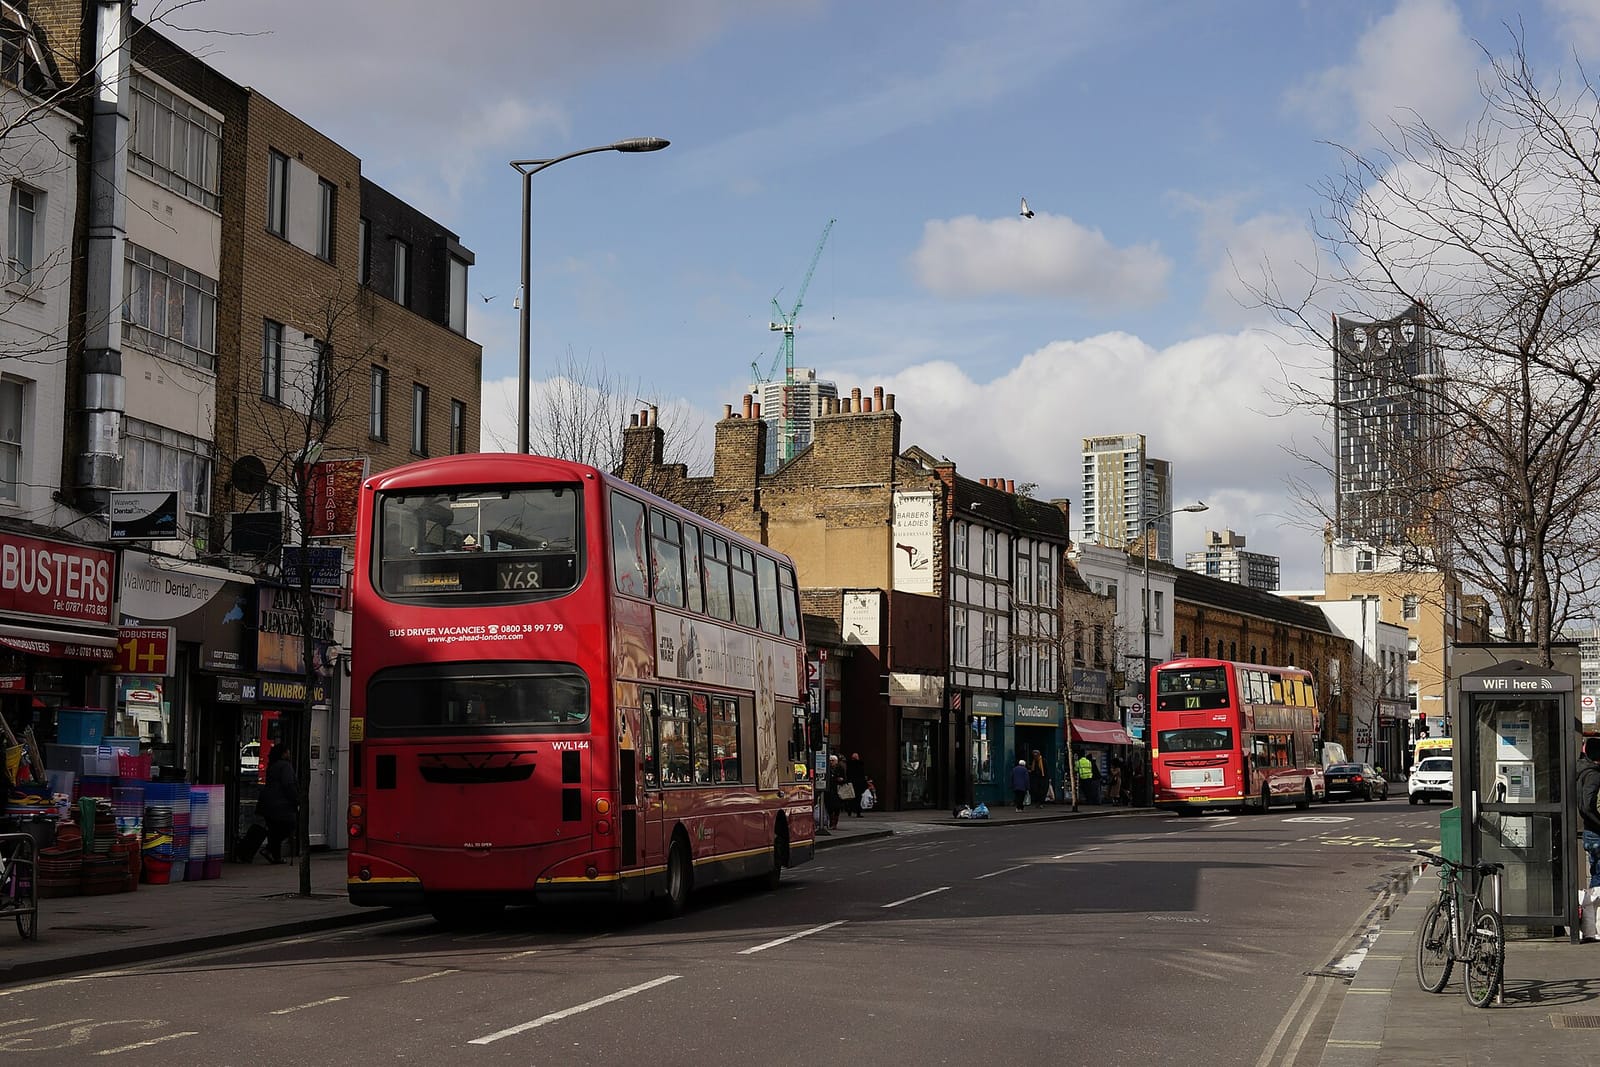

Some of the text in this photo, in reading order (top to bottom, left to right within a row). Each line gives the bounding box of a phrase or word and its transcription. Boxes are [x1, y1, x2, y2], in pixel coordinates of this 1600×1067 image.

[325, 463, 336, 531] KEBABS
[896, 511, 930, 520] BARBERS
[903, 519, 930, 527] LADIES
[0, 544, 109, 602] BUSTERS
[124, 571, 209, 601] Walworth DentalCare
[65, 602, 83, 612] 07871
[389, 623, 564, 637] BUS DRIVER VACANCIES 0800 38 99 7 99
[427, 632, 523, 644] www.go-ahead-london.com
[820, 650, 828, 660] H
[1513, 679, 1537, 689] here
[242, 685, 256, 698] NHS
[1186, 697, 1200, 708] 171
[1017, 703, 1049, 718] Poundland
[552, 741, 589, 750] WVL144
